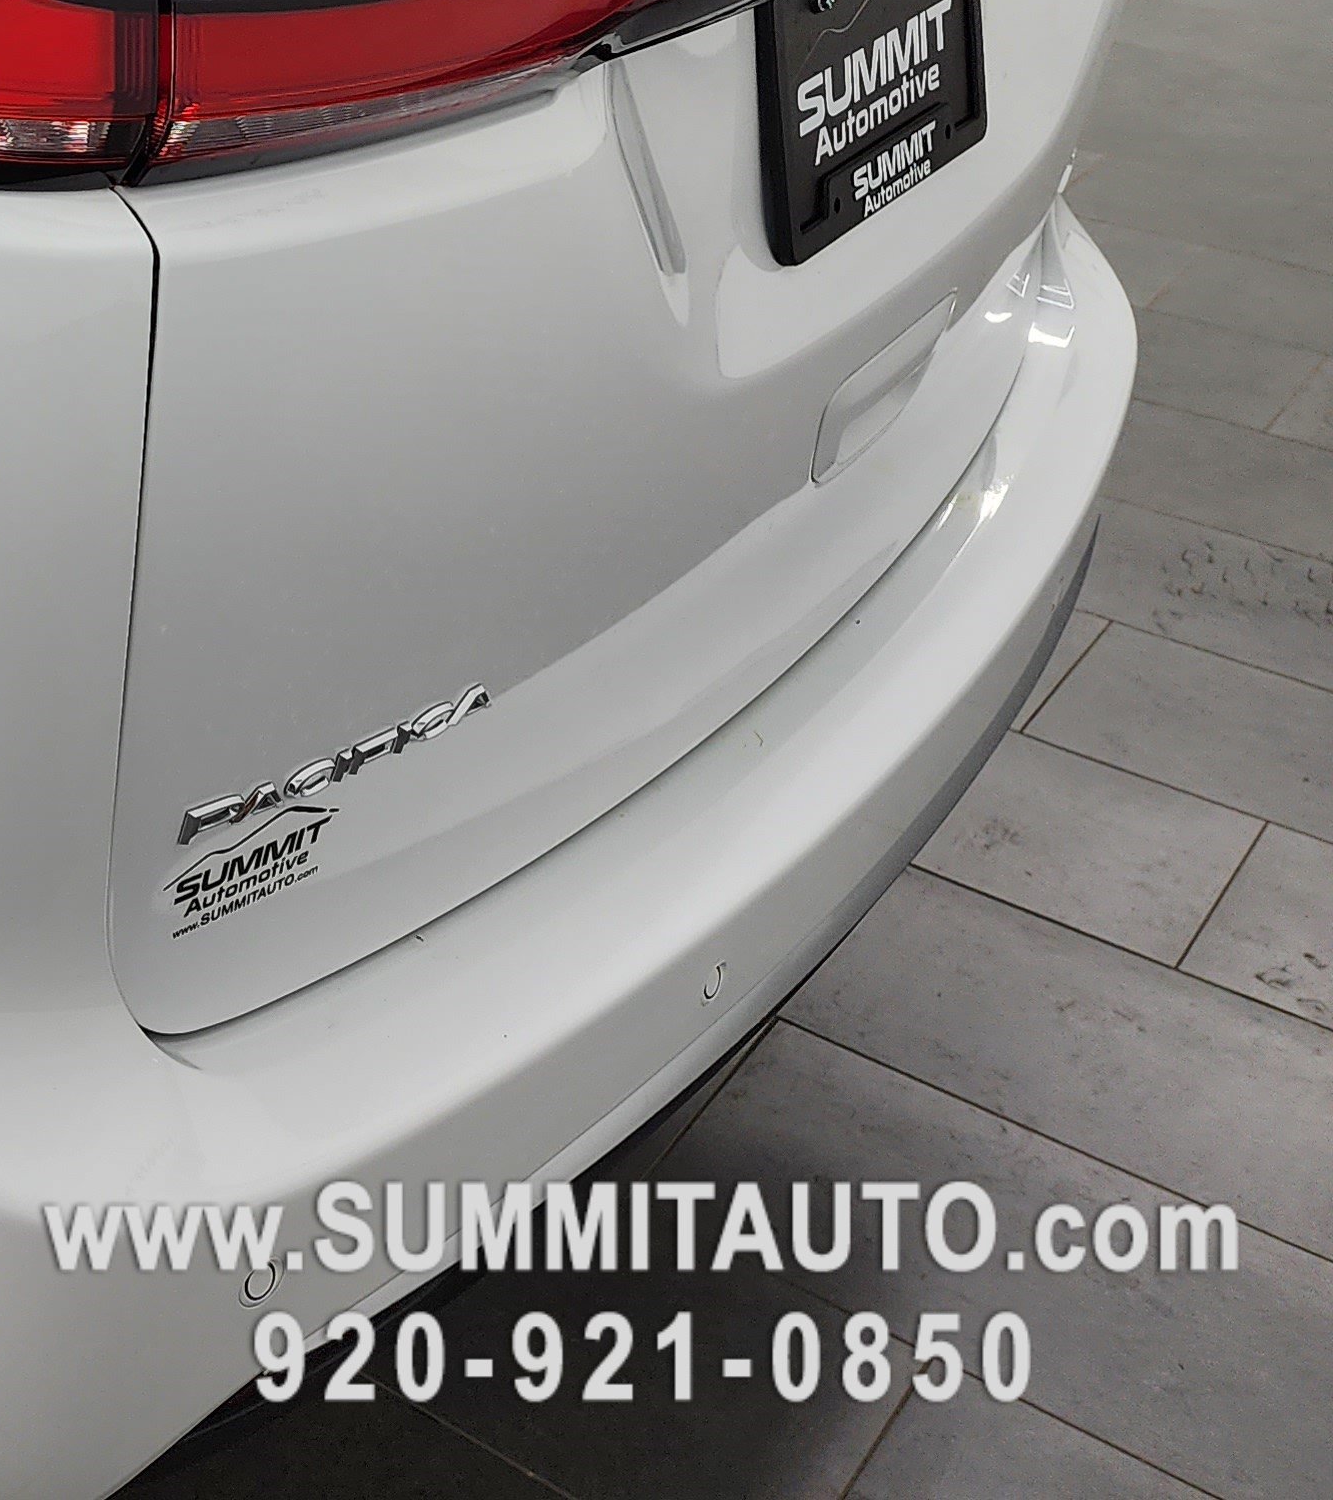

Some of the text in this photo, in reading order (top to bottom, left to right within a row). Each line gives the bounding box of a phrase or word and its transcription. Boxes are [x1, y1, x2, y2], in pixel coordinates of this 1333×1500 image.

[814, 62, 940, 166] Automotive
[852, 120, 936, 201] SUMMIT
[863, 158, 932, 218] Automotive
[177, 682, 491, 845] PACIFICA
[173, 814, 333, 906] SUMMIT
[183, 850, 310, 918] Automotive
[171, 864, 319, 939] www.SUMMITAUTO.com
